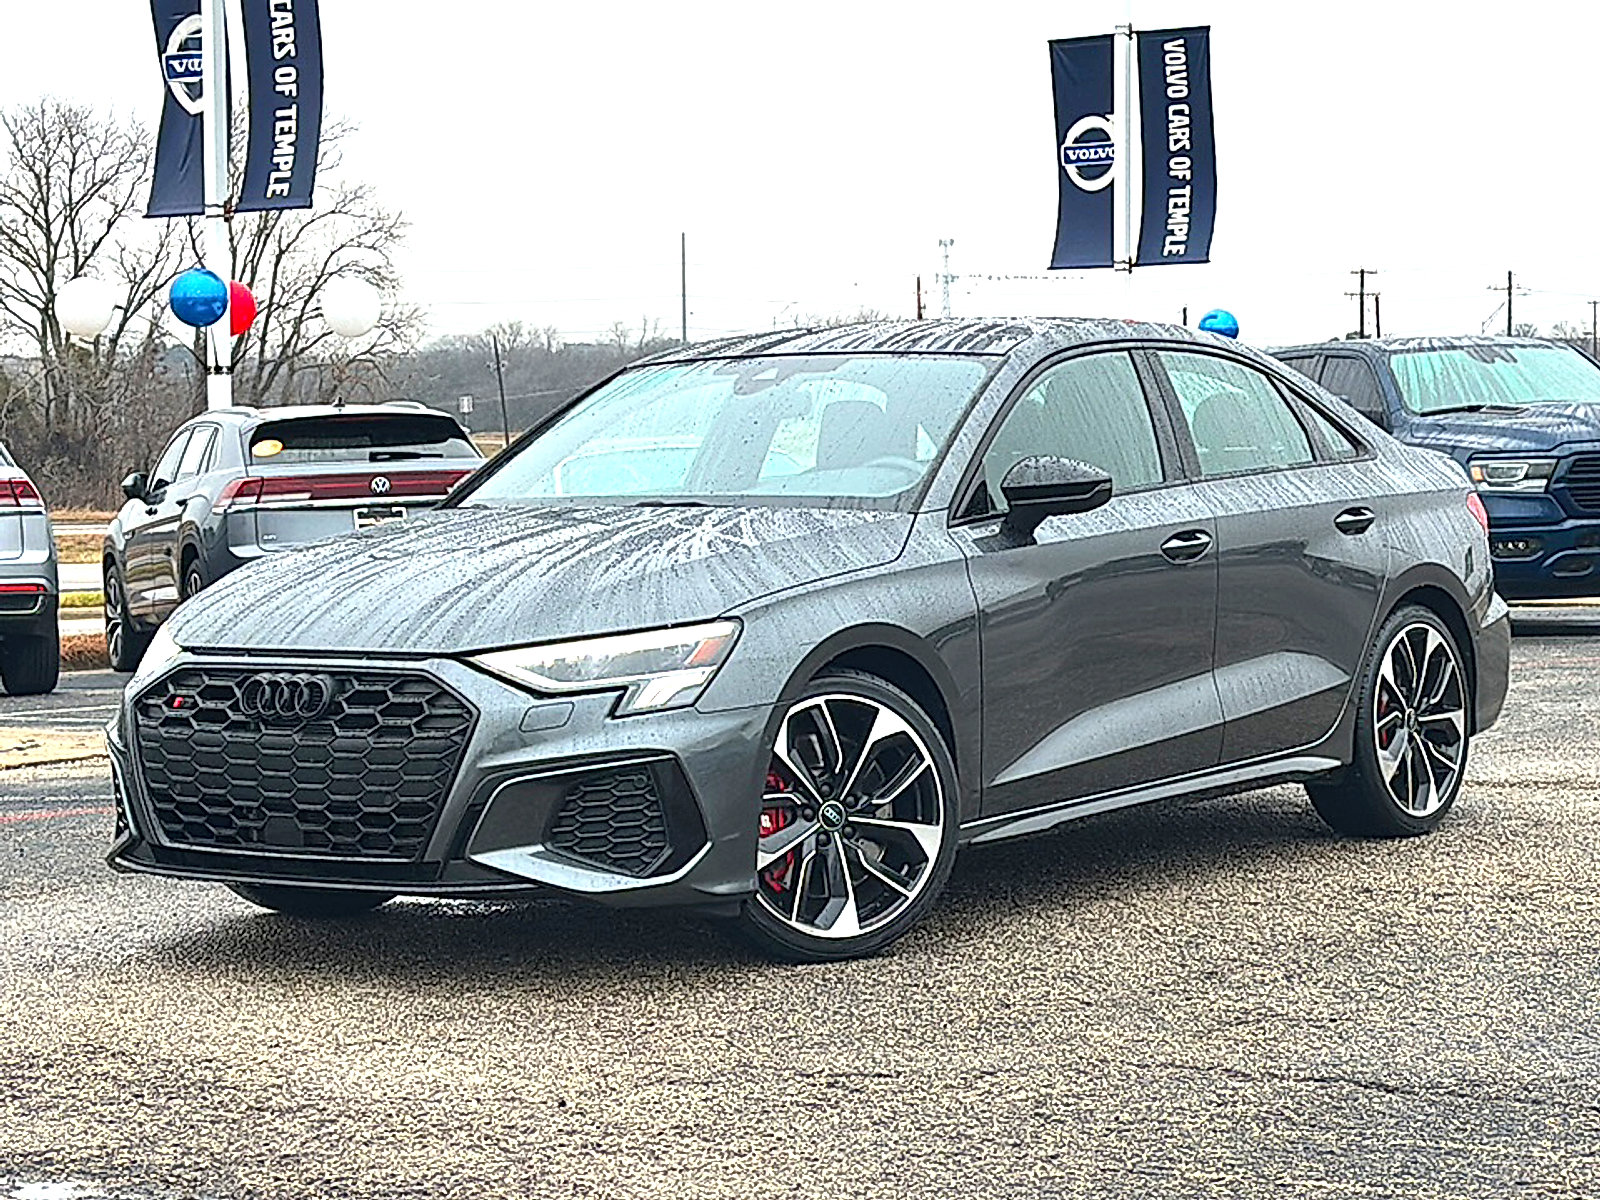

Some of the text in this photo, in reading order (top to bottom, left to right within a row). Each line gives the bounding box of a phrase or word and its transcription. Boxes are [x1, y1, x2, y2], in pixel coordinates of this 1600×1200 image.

[266, 0, 298, 198] CARS OF TEMPLE
[1163, 39, 1191, 257] VOLVO CARS OF TEMPLE
